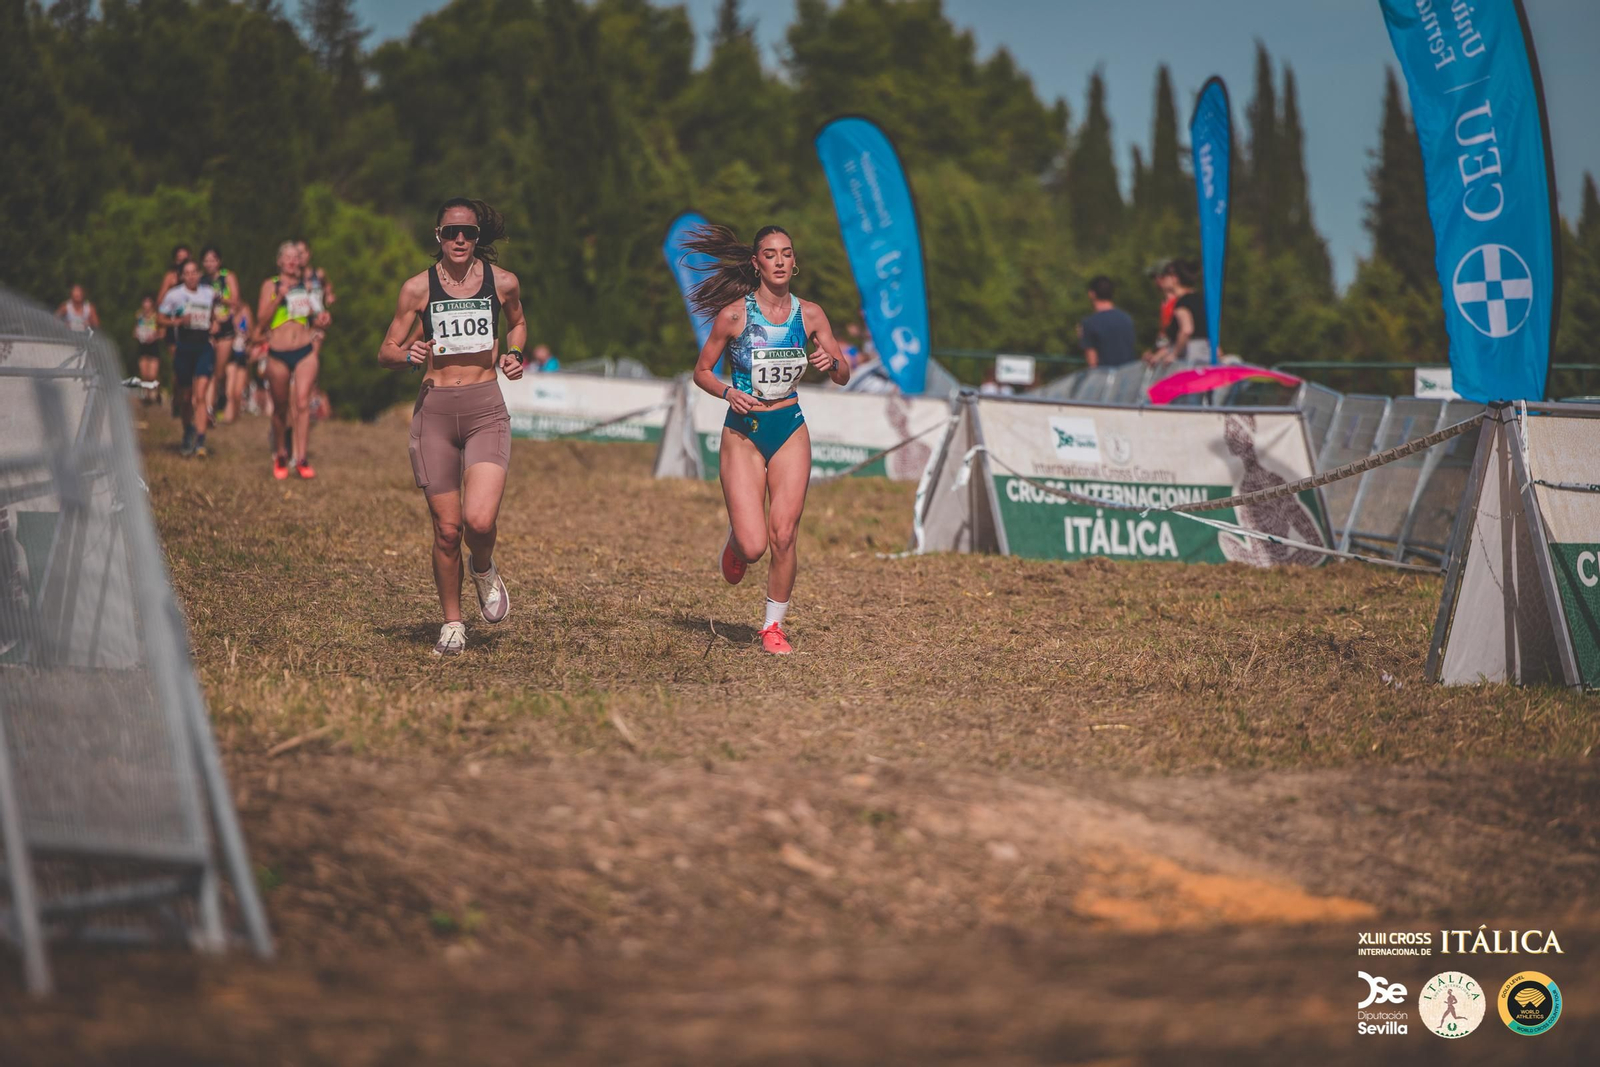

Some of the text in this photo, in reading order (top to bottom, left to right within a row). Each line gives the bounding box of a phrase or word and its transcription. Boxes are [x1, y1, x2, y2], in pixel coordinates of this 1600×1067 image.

[438, 317, 489, 339] 1108
[758, 365, 803, 384] 1352
[1006, 479, 1209, 507] CROSS INTERNACIONAL
[1064, 509, 1179, 558] ITÁLICA
